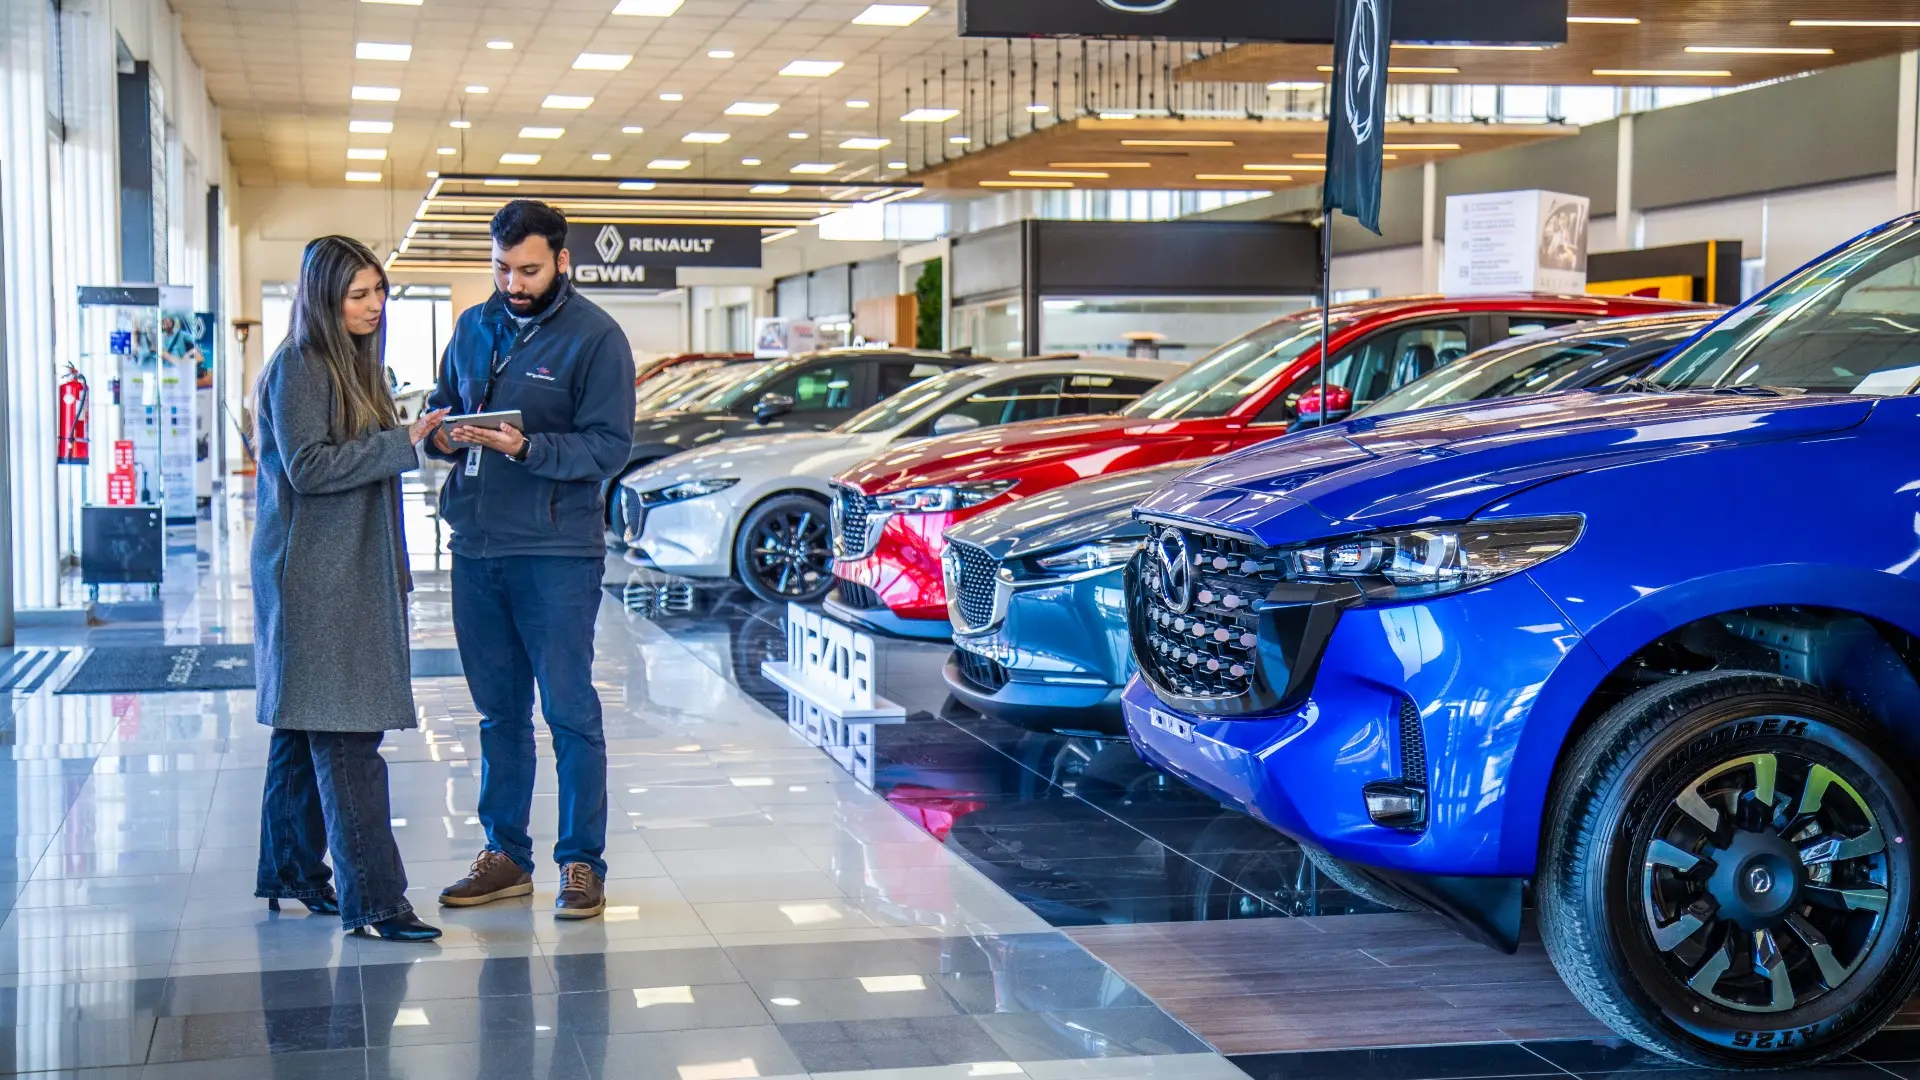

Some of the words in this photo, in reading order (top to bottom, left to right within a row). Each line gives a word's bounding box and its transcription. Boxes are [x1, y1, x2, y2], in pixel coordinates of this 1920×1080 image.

[629, 238, 715, 253] RENAULT
[575, 265, 645, 283] GWM
[1731, 1023, 1821, 1050] AT25
